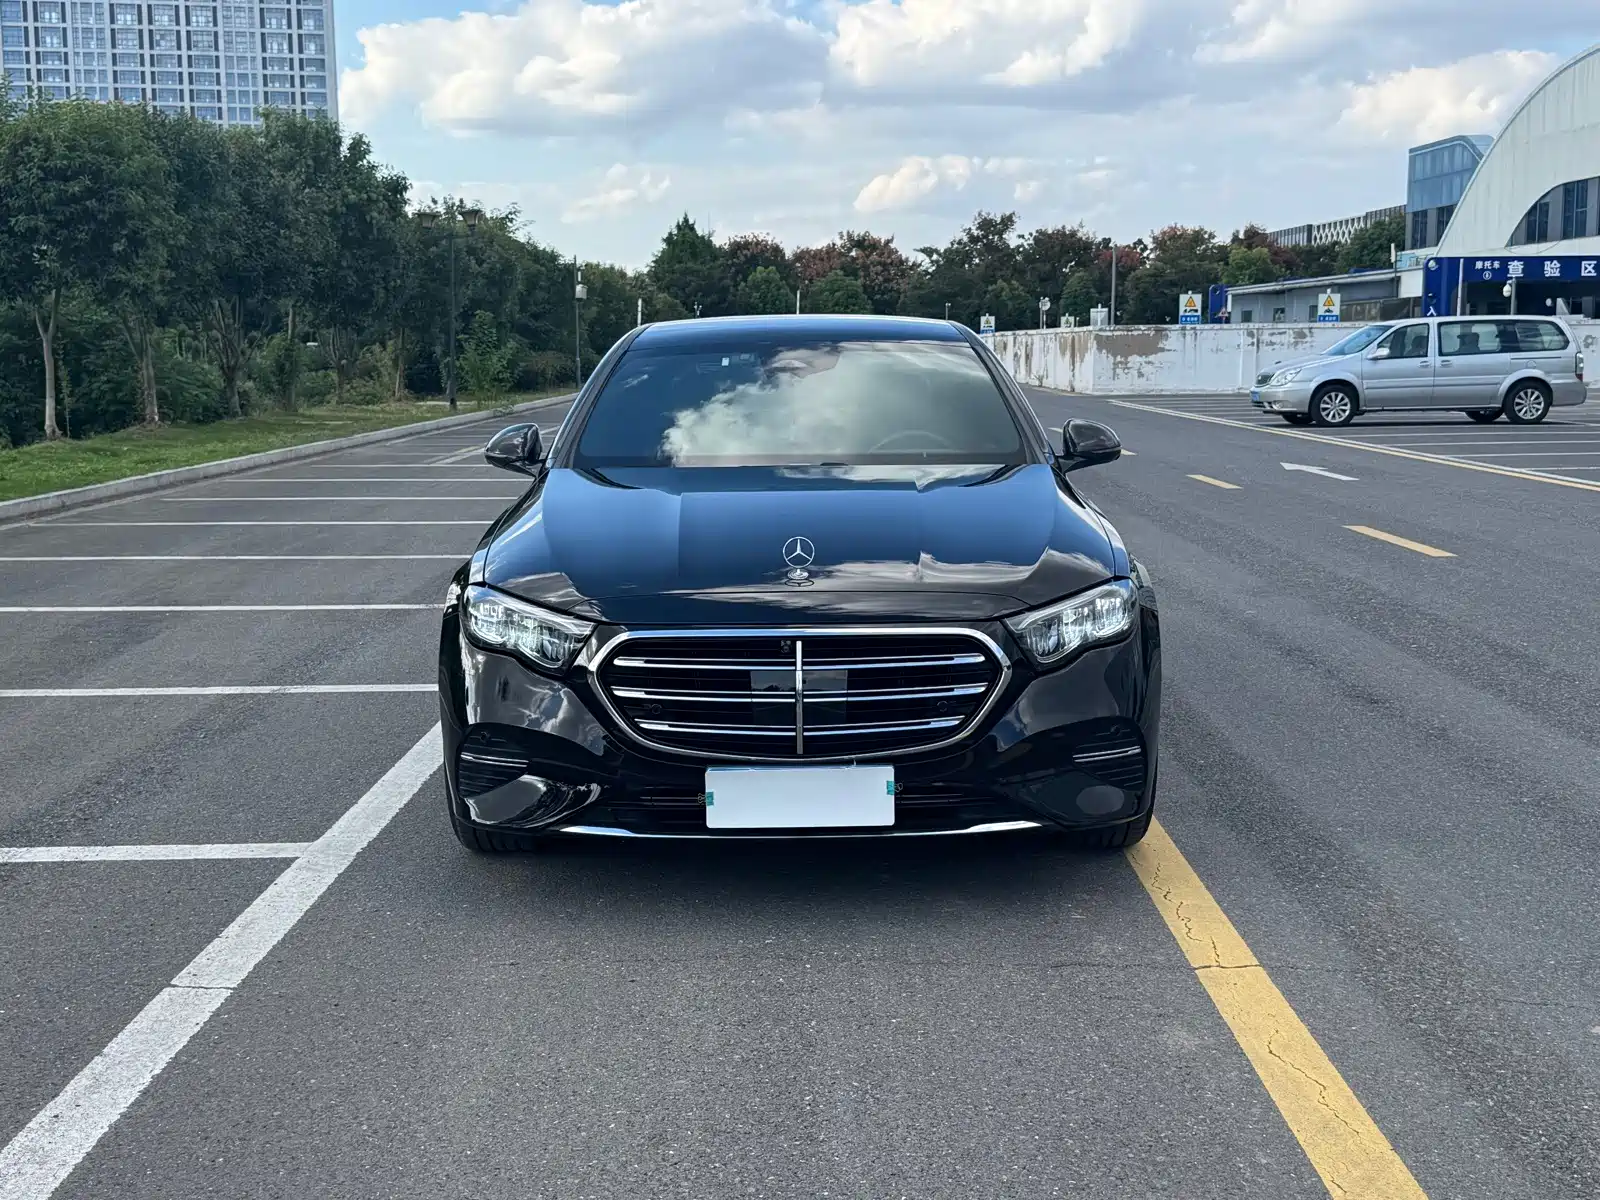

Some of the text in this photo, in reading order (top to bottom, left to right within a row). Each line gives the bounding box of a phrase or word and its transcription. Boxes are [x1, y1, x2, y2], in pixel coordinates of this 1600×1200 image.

[1507, 260, 1598, 278] 查验区
[1426, 306, 1437, 317] 入
